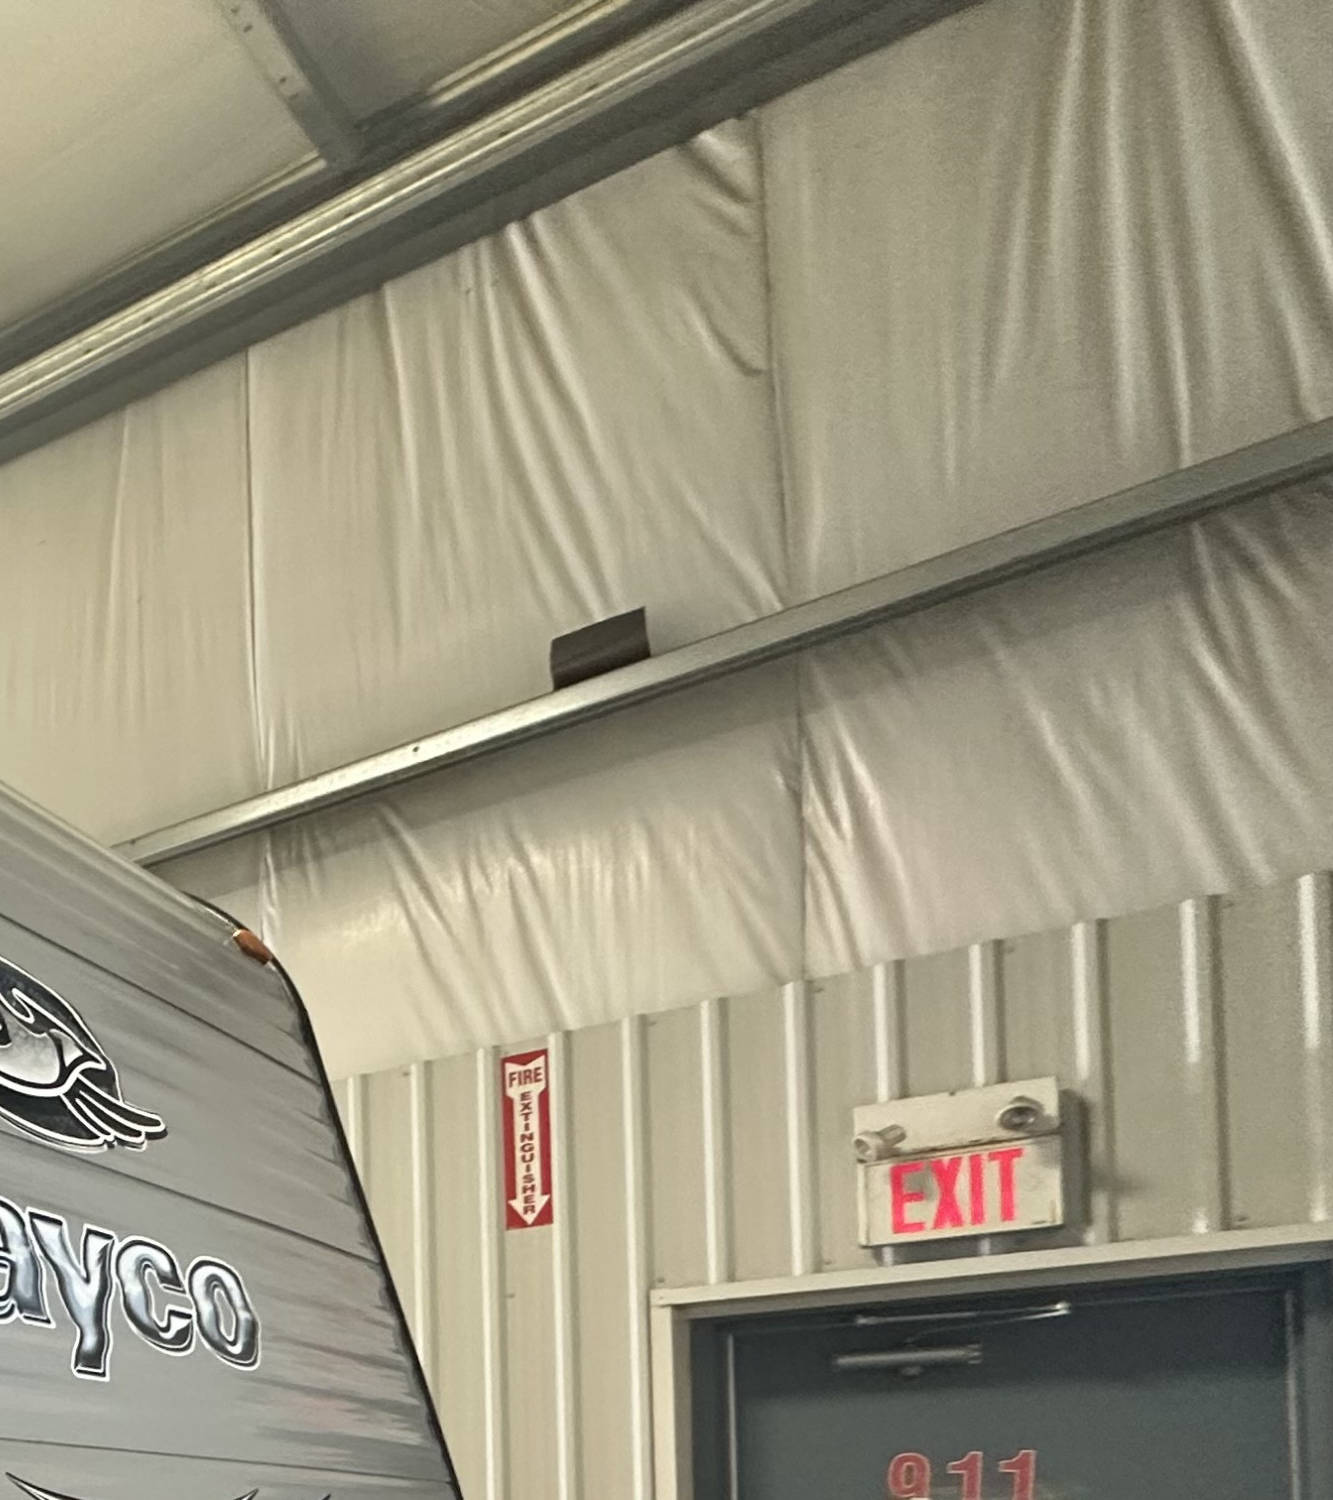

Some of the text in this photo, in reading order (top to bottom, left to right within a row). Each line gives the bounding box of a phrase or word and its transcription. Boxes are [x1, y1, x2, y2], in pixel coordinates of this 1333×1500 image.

[508, 1066, 543, 1088] FIRE
[519, 1091, 536, 1215] EXTINGUISHER
[889, 1147, 1024, 1235] EXIT
